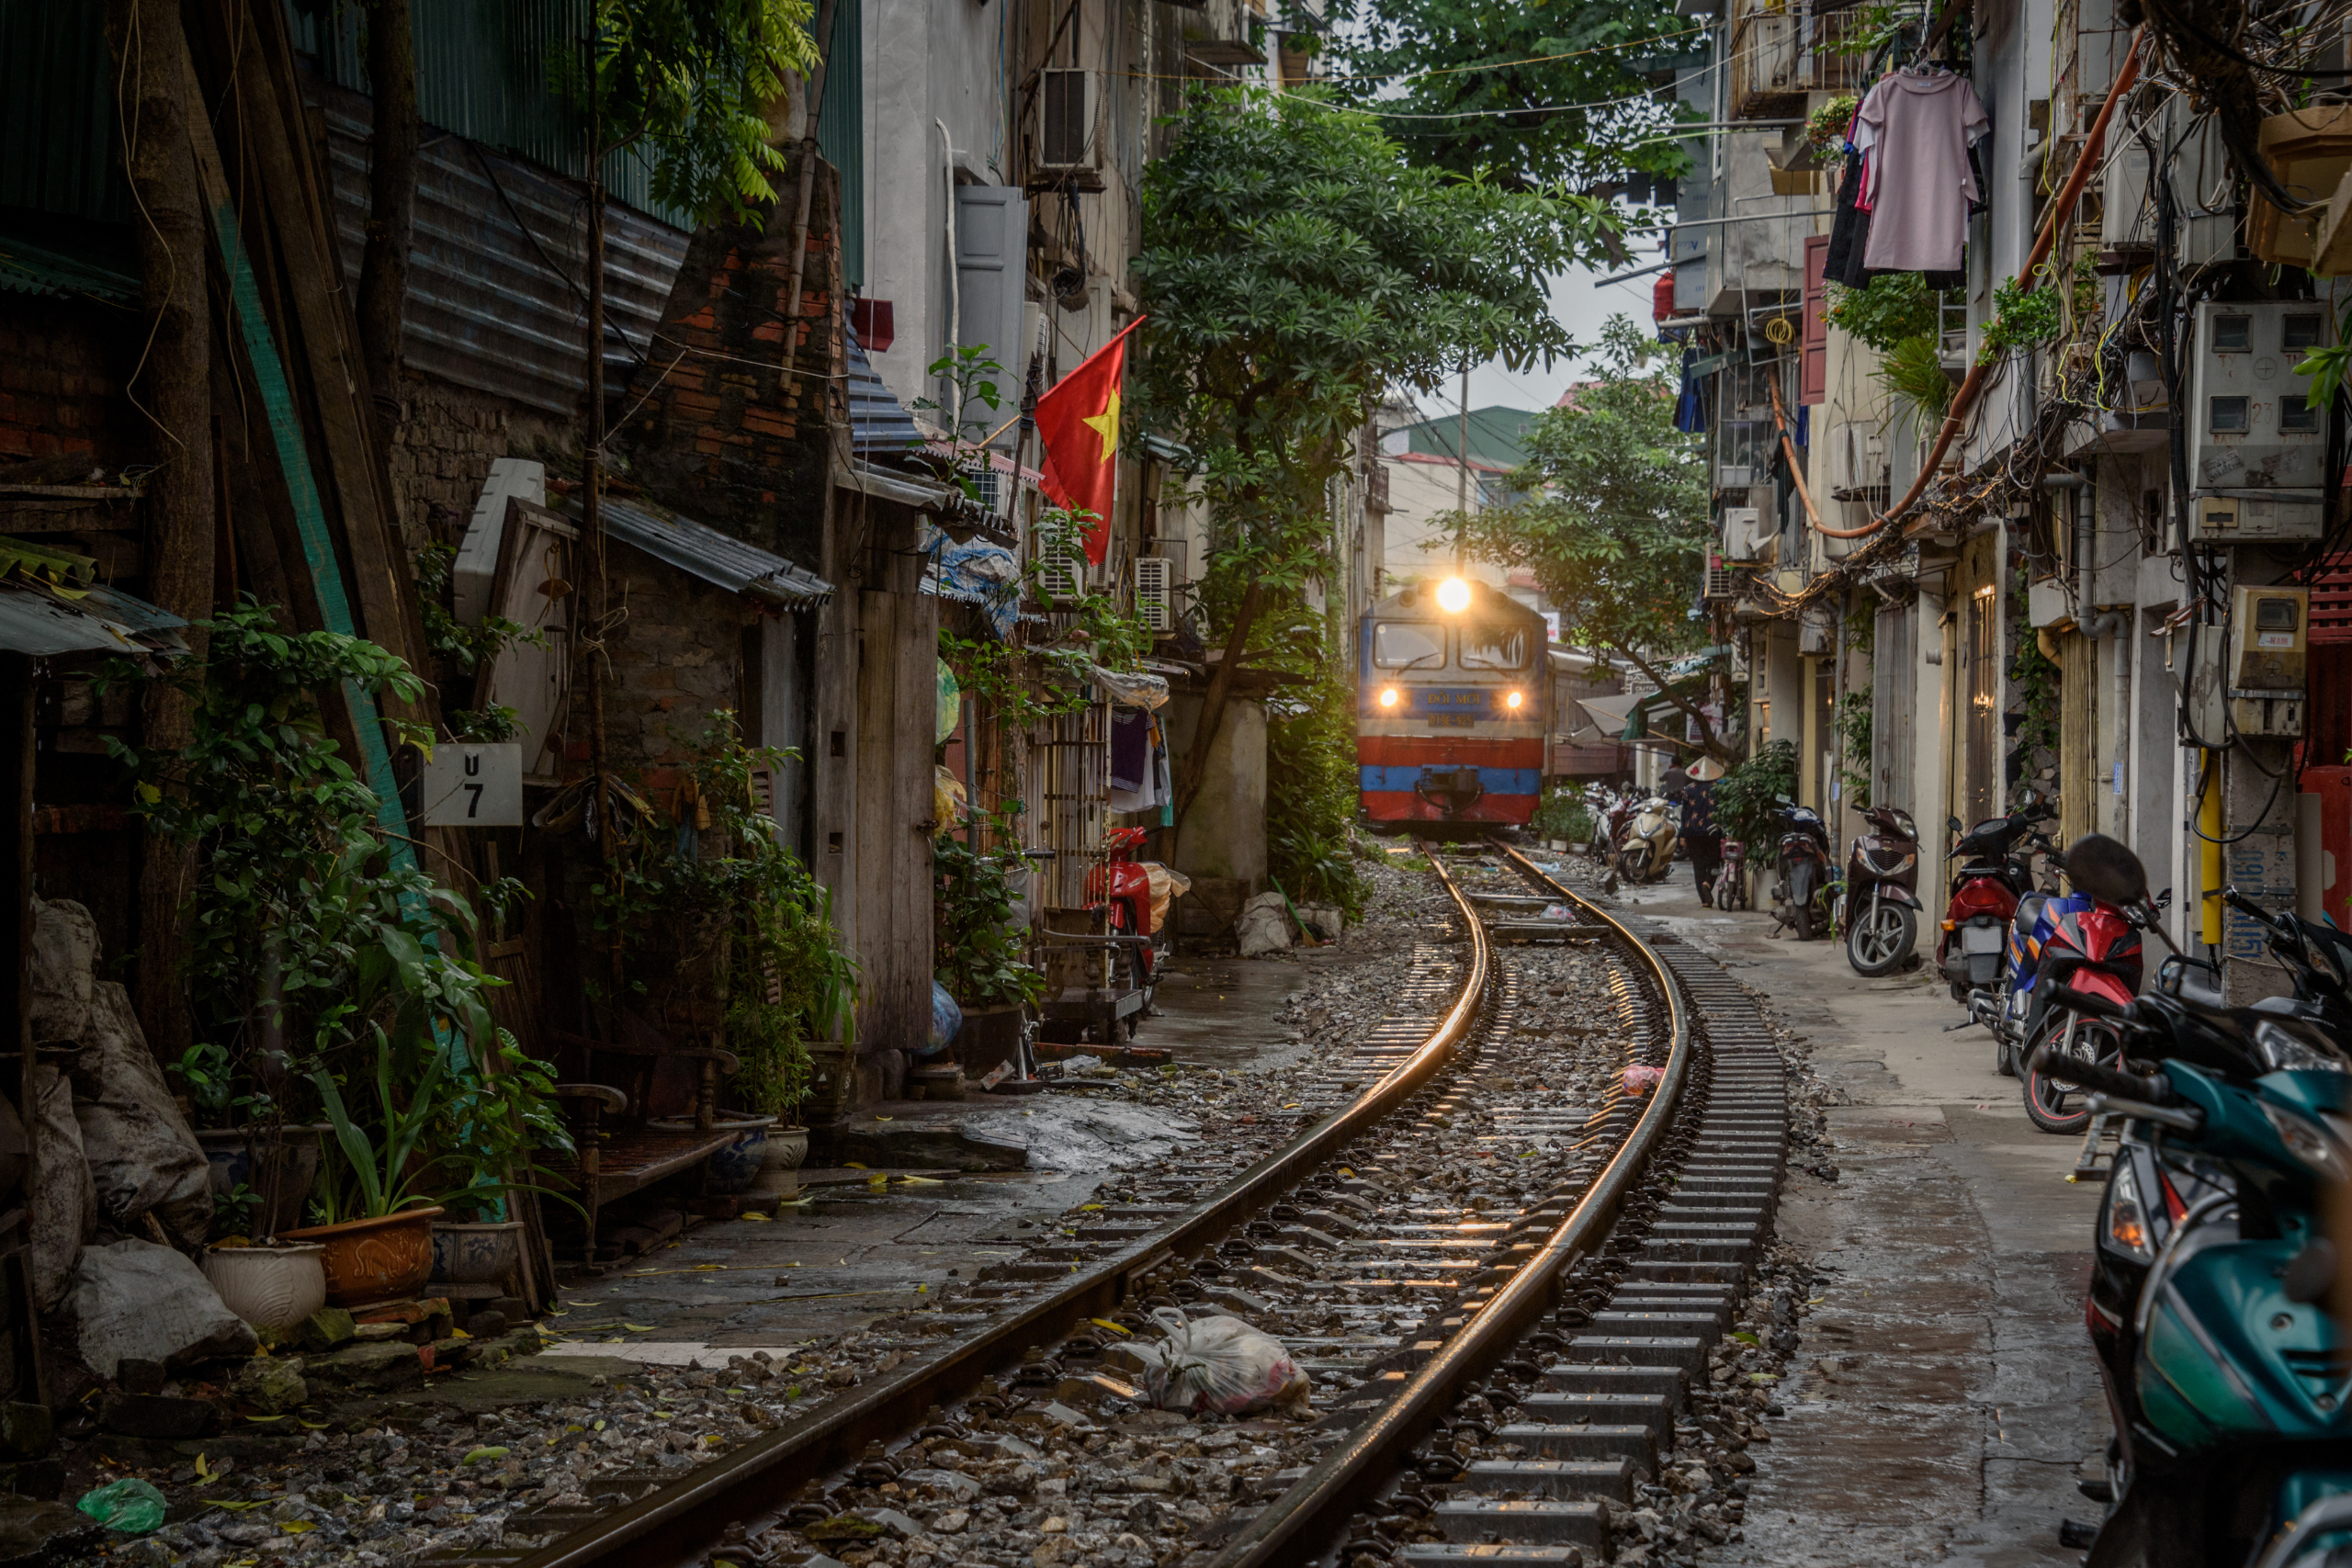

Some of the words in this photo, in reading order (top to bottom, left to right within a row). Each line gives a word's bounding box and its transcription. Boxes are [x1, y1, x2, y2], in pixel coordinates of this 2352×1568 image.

[2252, 402, 2273, 424] 23
[1430, 715, 1473, 726] D19E-925
[465, 753, 480, 777] U
[464, 784, 483, 818] 7
[2301, 1015, 2338, 1030] HONDA
